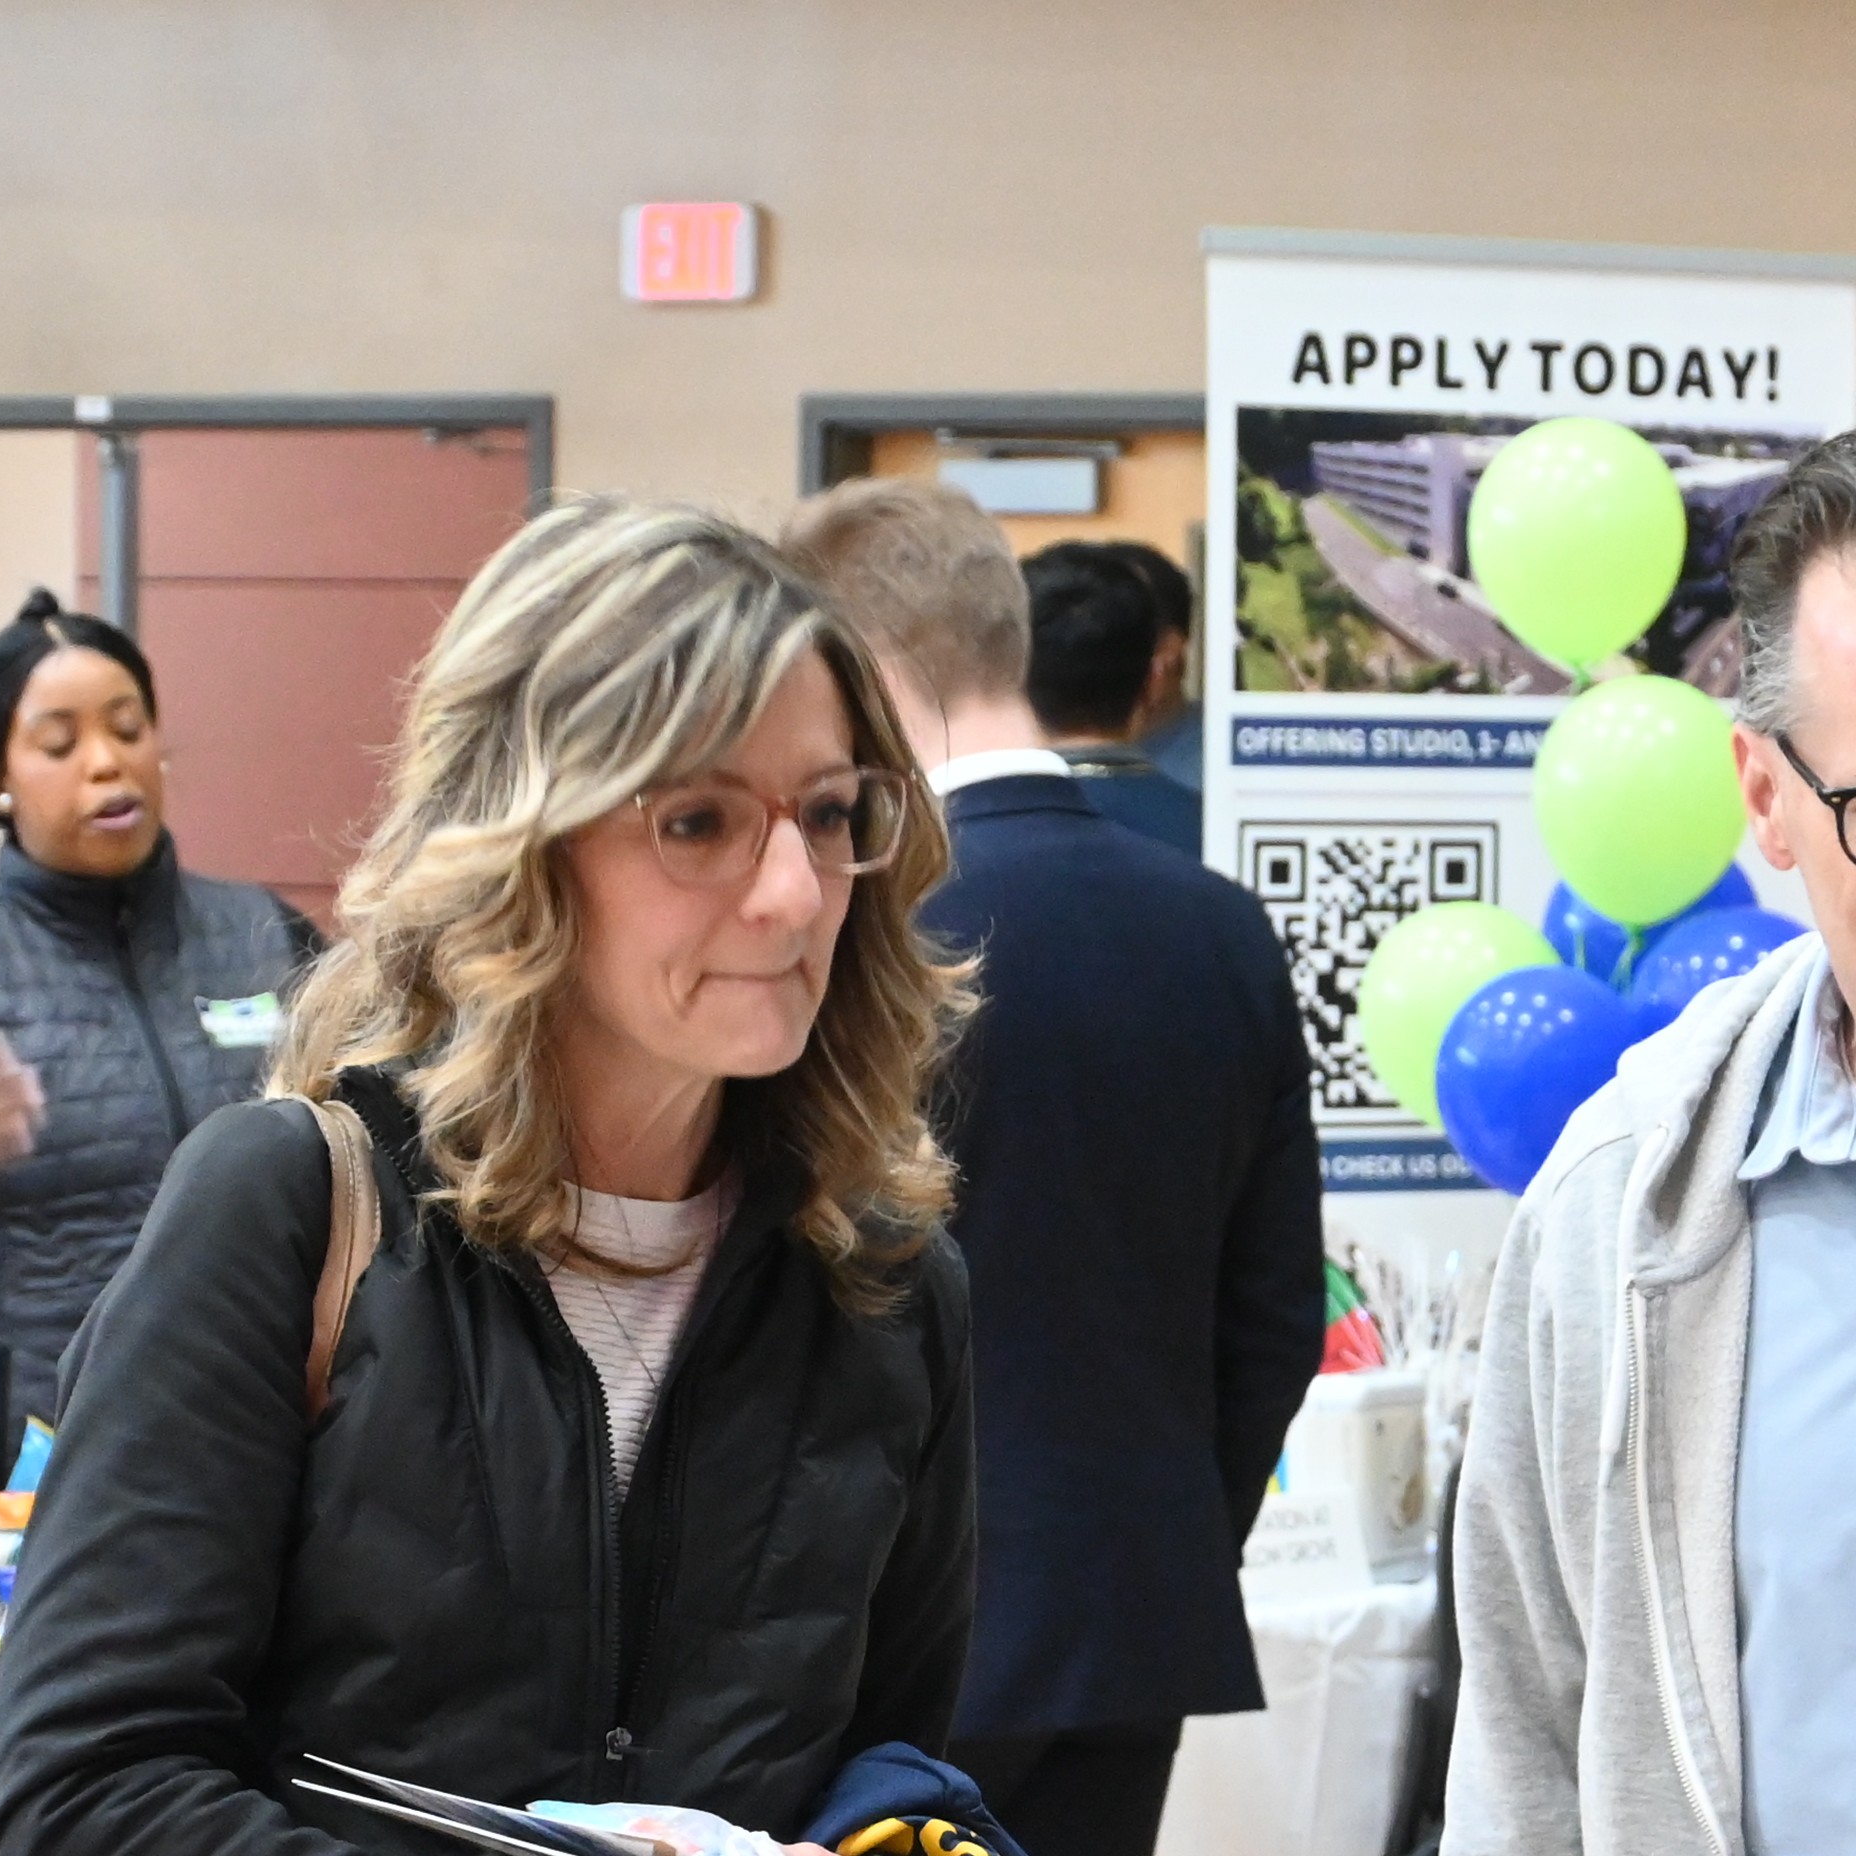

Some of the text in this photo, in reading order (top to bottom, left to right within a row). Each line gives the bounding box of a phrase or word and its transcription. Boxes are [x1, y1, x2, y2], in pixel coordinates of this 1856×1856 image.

[640, 206, 743, 299] EXIT
[1292, 331, 1780, 401] APPLY TODAY!
[1236, 726, 1367, 758] OFFERING
[1369, 727, 1475, 764] STUDIO,
[1503, 729, 1544, 759] AN
[1331, 1154, 1405, 1181] CHECK
[1406, 1153, 1437, 1180] US
